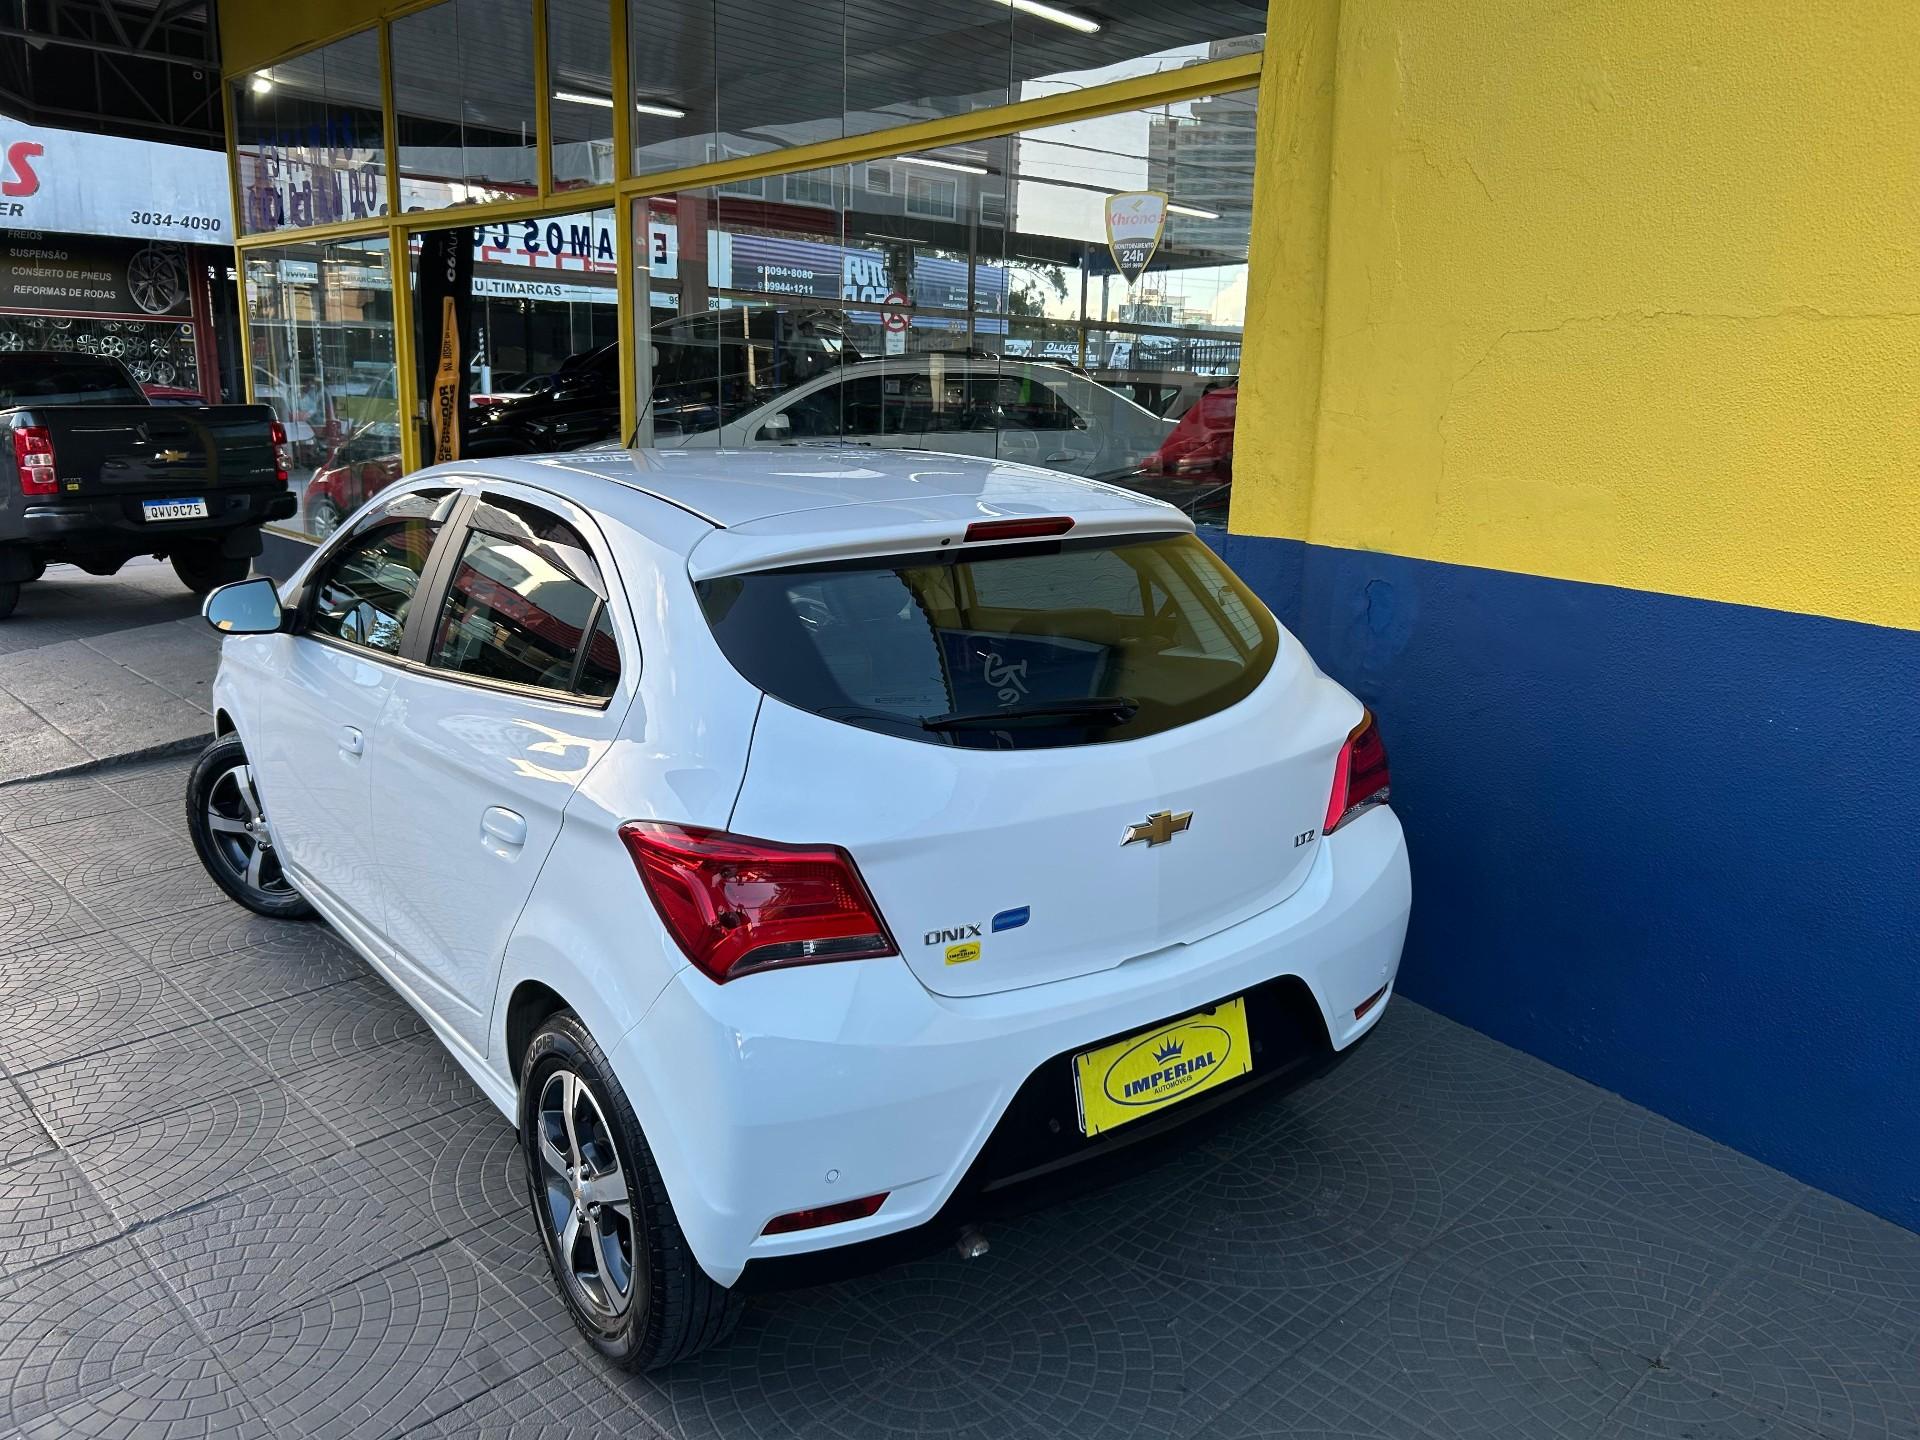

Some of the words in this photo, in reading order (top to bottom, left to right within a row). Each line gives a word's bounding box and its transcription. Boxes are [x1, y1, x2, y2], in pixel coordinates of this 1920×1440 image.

[130, 211, 221, 231] 3034-4090
[1108, 210, 1166, 226] Khronos
[7, 229, 43, 240] FREIOS
[9, 247, 68, 260] SUSPENSÃO
[1123, 249, 1144, 262] 24h
[11, 266, 64, 278] CONSERTO
[66, 270, 79, 279] DE
[81, 271, 112, 281] PNEUS
[13, 284, 66, 296] REFORMAS
[69, 288, 82, 297] DE
[84, 289, 116, 299] RODAS
[472, 279, 561, 297] ULTIMARCAS
[151, 504, 201, 518] QWV9C75
[1294, 829, 1315, 847] LTZ
[924, 922, 982, 946] ONIX
[1124, 1051, 1217, 1098] IMPERIAL
